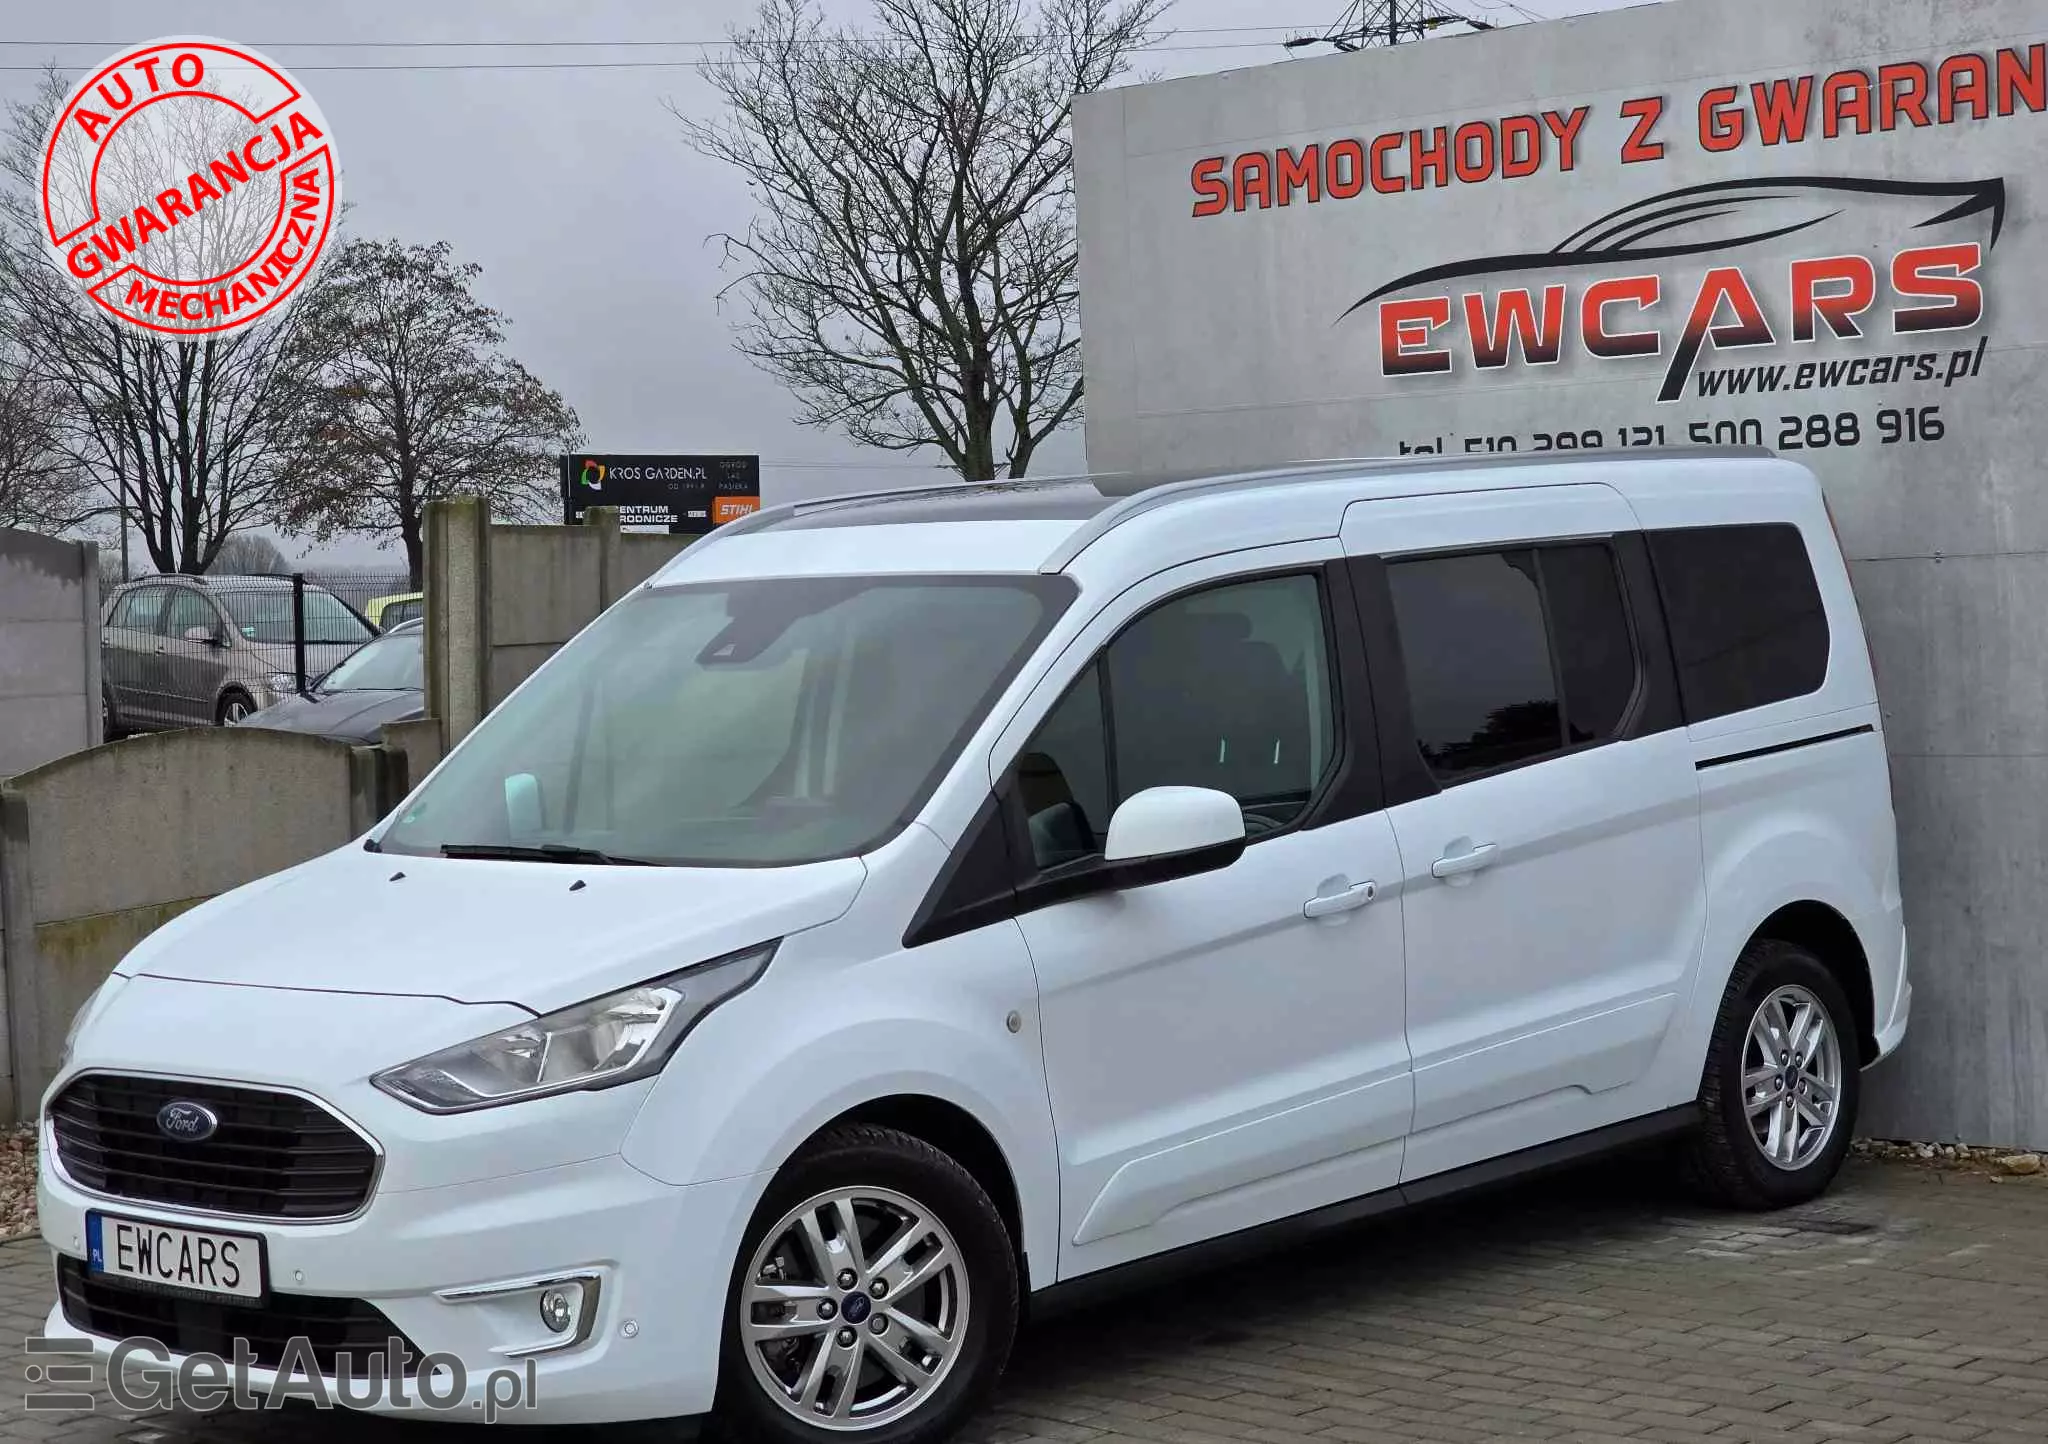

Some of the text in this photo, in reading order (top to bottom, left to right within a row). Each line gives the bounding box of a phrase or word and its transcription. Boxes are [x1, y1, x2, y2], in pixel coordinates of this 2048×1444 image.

[1191, 42, 2047, 218] SAMOCHODY Z GWARAN
[1379, 242, 1983, 404] EWCARS
[1698, 335, 1988, 397] www.ewcars.pl
[1778, 411, 1861, 451] 288
[1876, 405, 1945, 444] 916
[609, 466, 707, 480] KROS GARDEN.PL
[166, 1107, 200, 1132] Ford
[92, 1249, 102, 1262] PL
[117, 1223, 240, 1288] EWCARS
